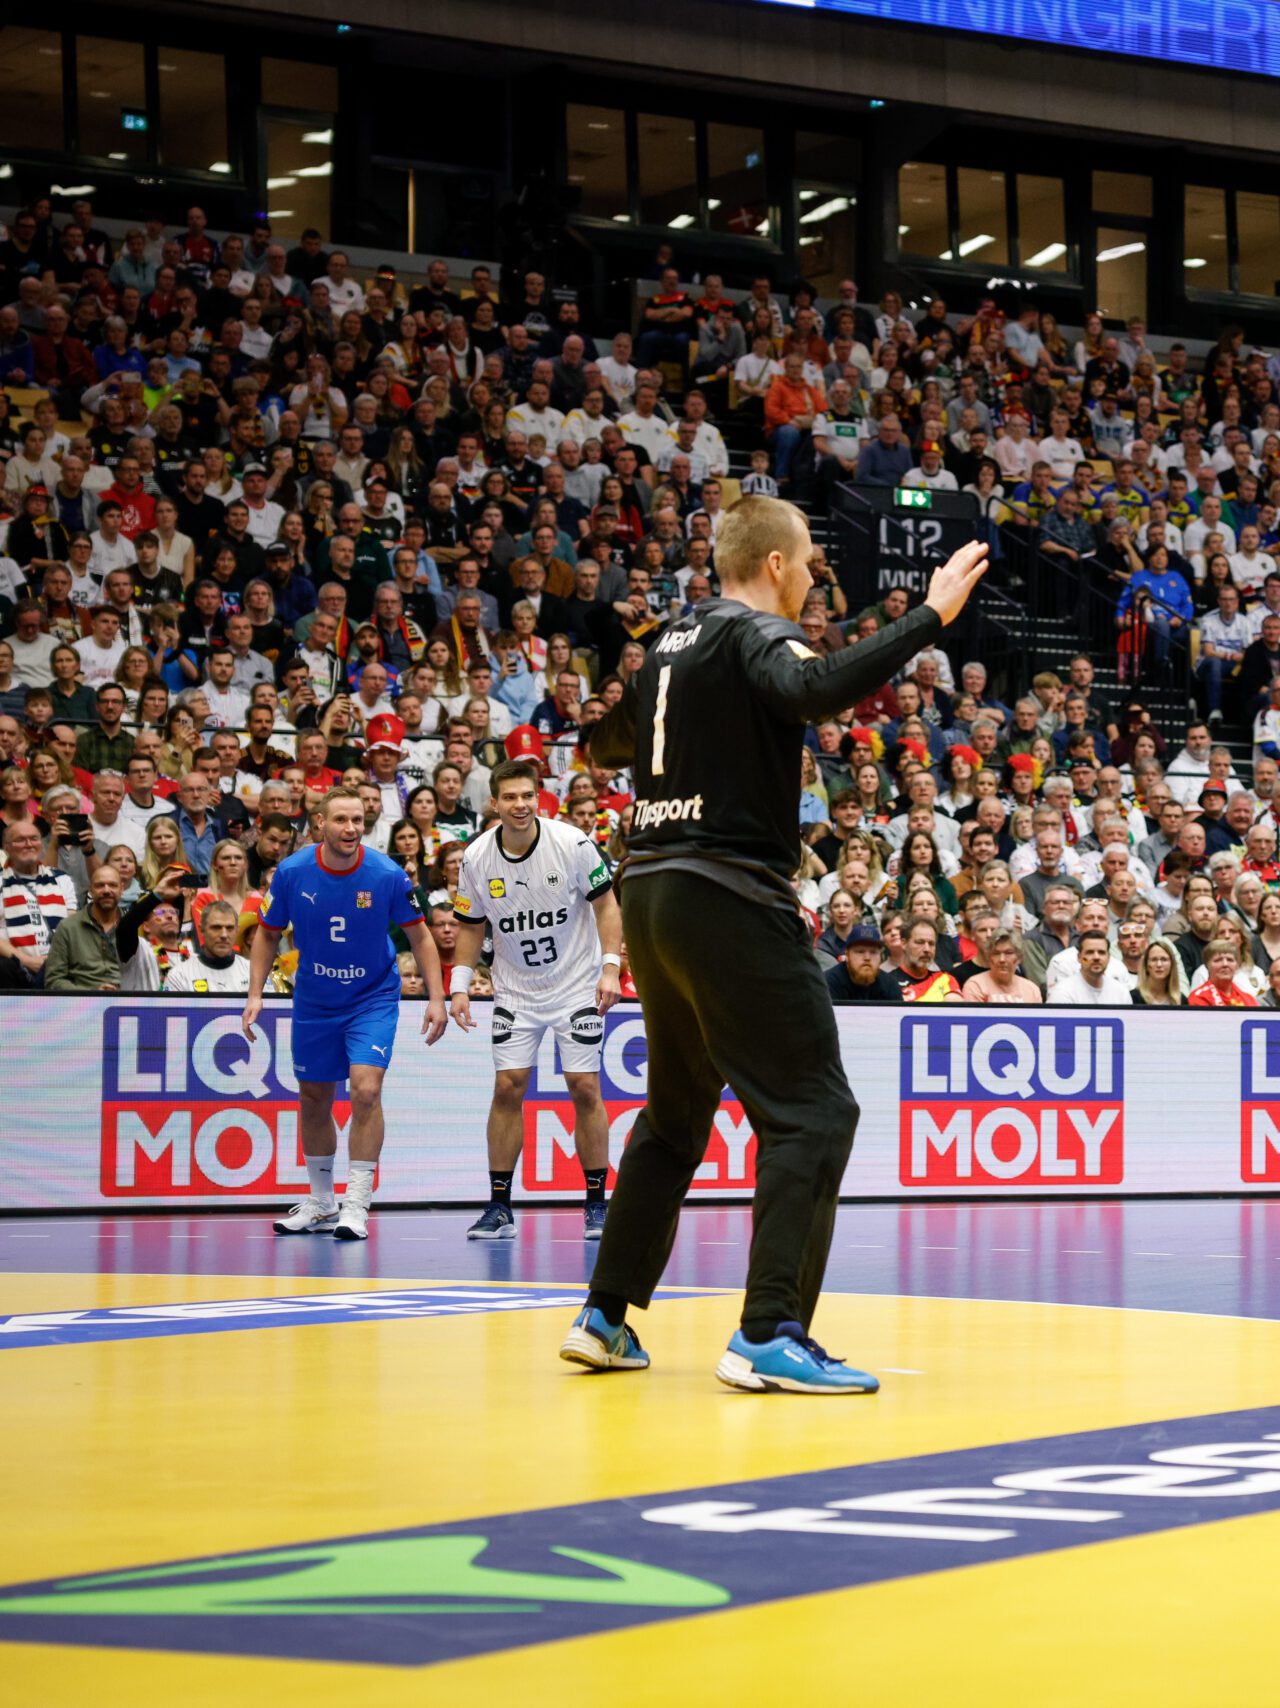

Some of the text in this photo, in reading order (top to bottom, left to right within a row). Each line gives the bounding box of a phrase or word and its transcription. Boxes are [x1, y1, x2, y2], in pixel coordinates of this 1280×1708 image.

[879, 518, 942, 557] L12
[878, 568, 926, 592] MC
[72, 591, 88, 603] 22
[652, 664, 671, 775] 1
[330, 916, 346, 942] 2
[500, 908, 568, 933] atlas
[520, 936, 558, 966] 23
[313, 962, 366, 980] Donio
[117, 1014, 300, 1099] LIQ
[912, 1023, 1113, 1099] LIQUI
[911, 1107, 1121, 1179] MOLY
